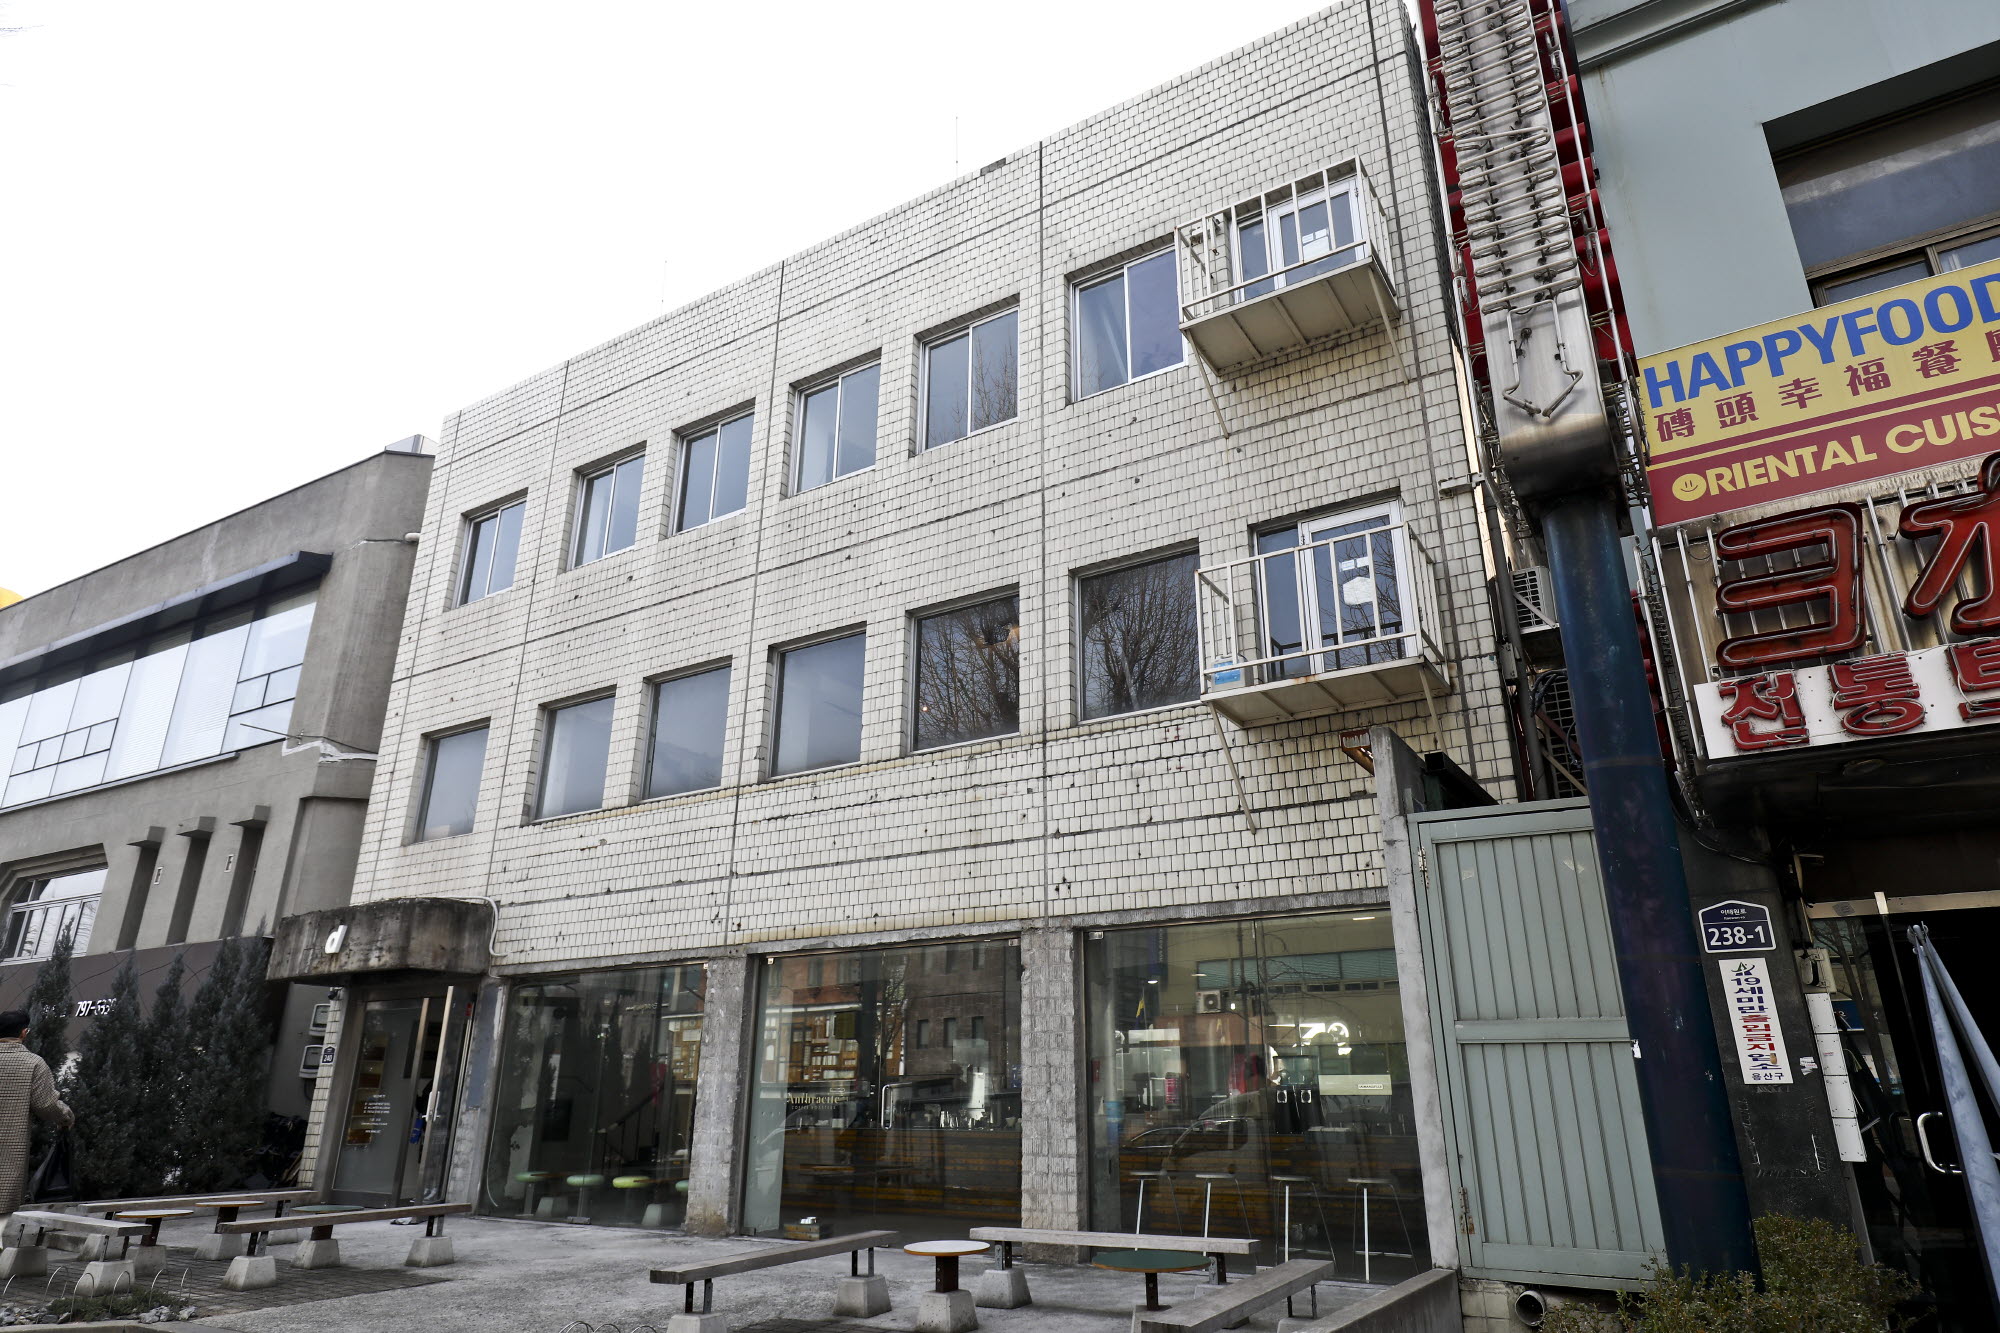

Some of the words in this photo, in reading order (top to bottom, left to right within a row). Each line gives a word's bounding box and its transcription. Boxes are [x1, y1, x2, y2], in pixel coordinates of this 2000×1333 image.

[1885, 402, 2000, 454] CUIS
[1707, 925, 1766, 946] 238-1
[1751, 1072, 1785, 1081] 용산구
